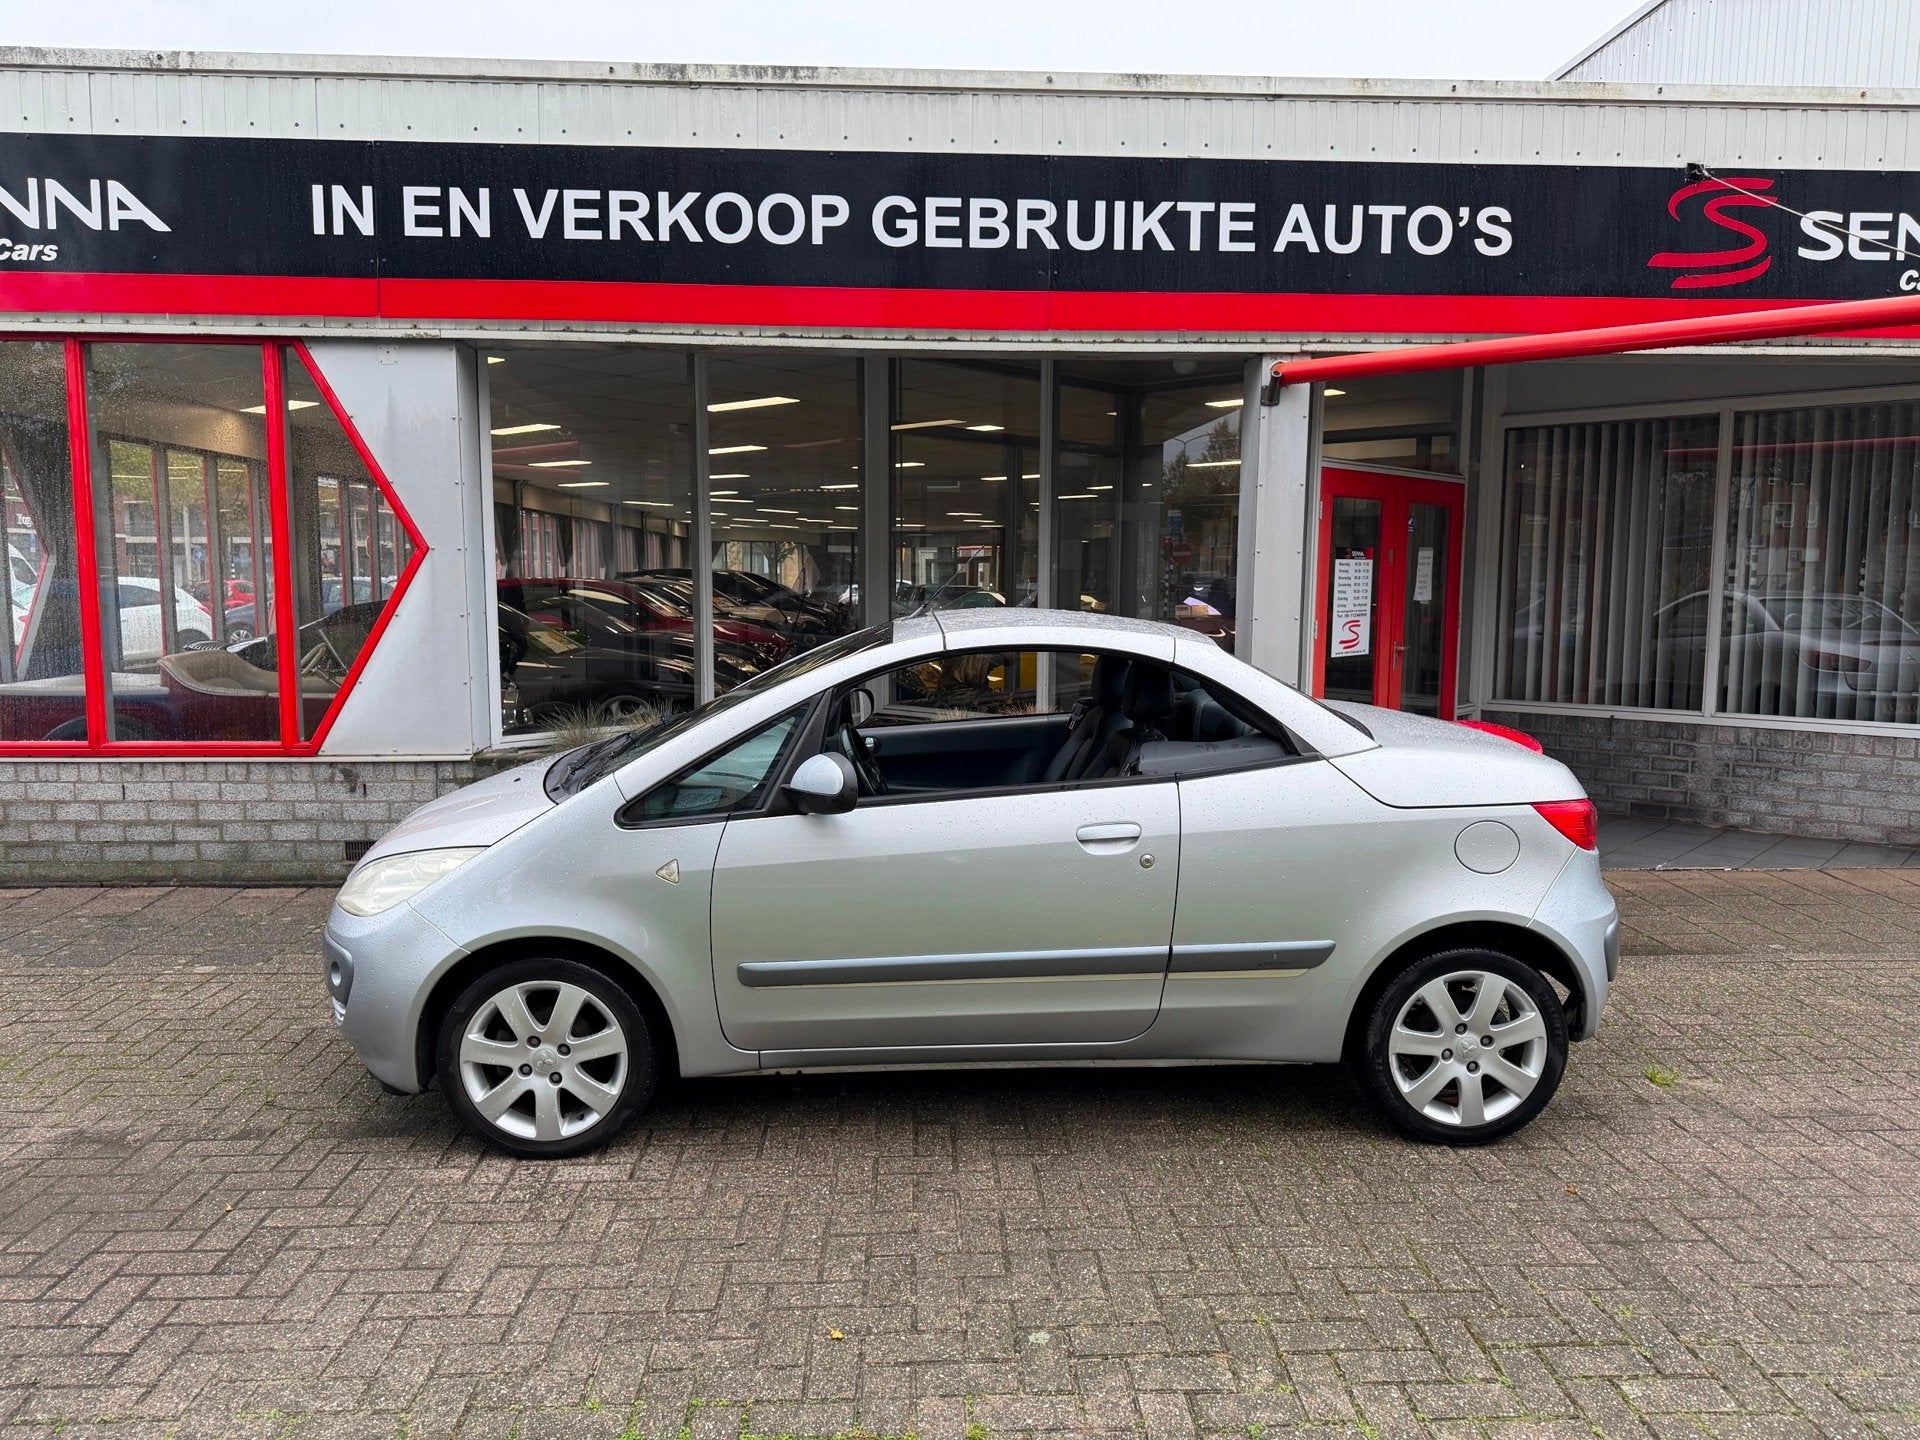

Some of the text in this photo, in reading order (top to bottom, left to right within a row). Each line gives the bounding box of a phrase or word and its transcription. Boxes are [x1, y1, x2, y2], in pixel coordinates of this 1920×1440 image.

[311, 184, 375, 236] IN
[403, 186, 491, 238] EN
[513, 189, 850, 245] VERKOOP
[871, 195, 1256, 252] GEBRUIKTE
